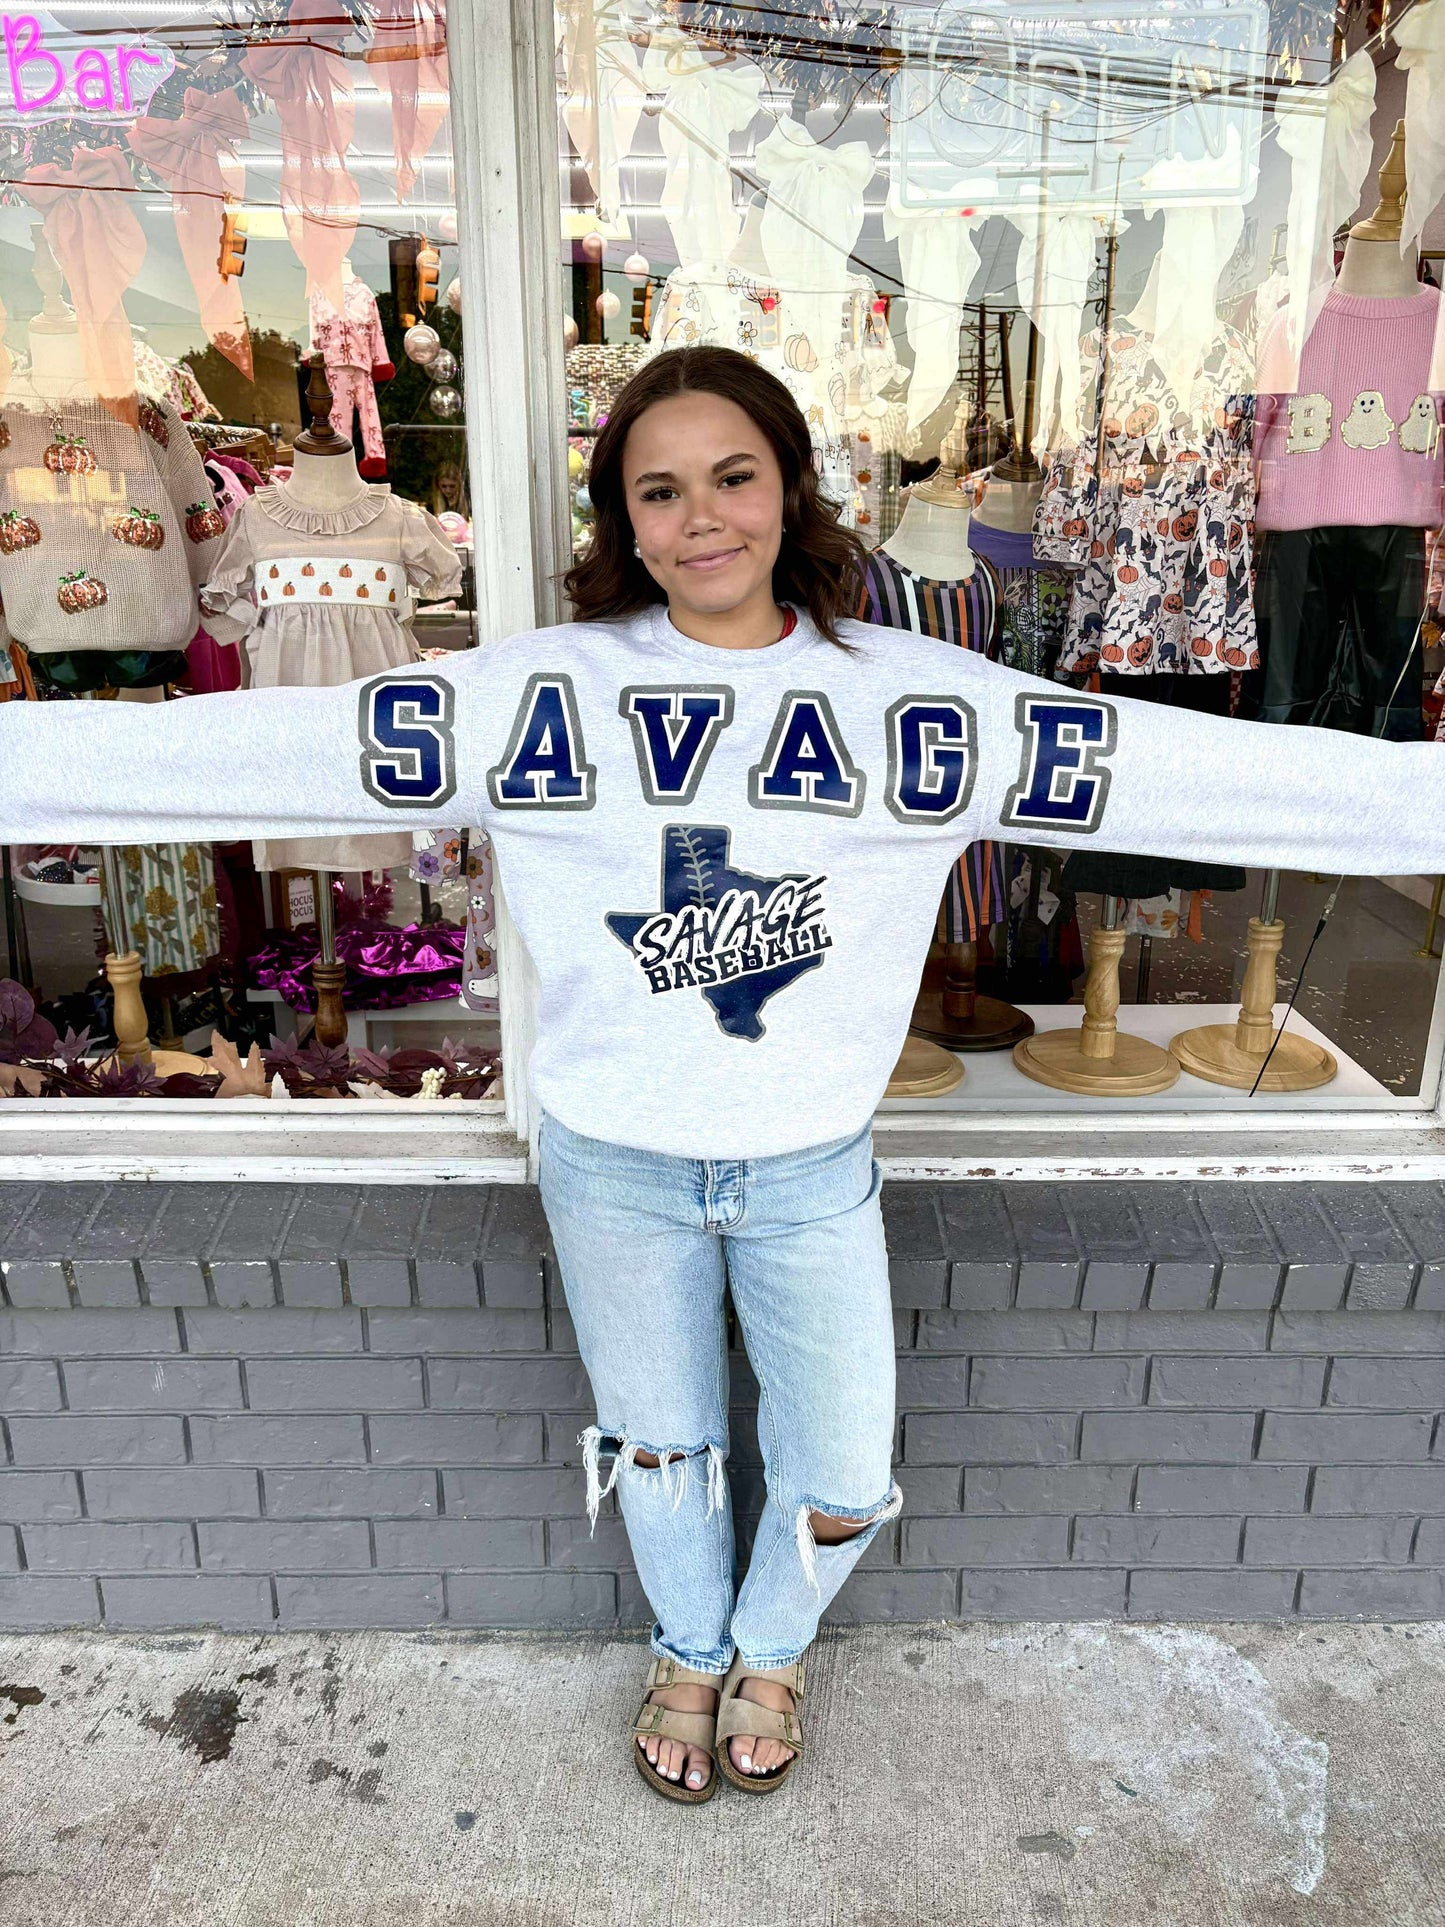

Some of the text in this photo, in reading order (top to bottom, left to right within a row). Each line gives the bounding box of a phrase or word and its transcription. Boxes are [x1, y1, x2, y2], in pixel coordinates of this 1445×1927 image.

[2, 13, 162, 113] Bar
[928, 6, 1230, 168] OPEN
[359, 673, 1118, 834] SAVAGE
[639, 875, 828, 969] SAVAGE
[645, 924, 833, 994] BASEBALL
